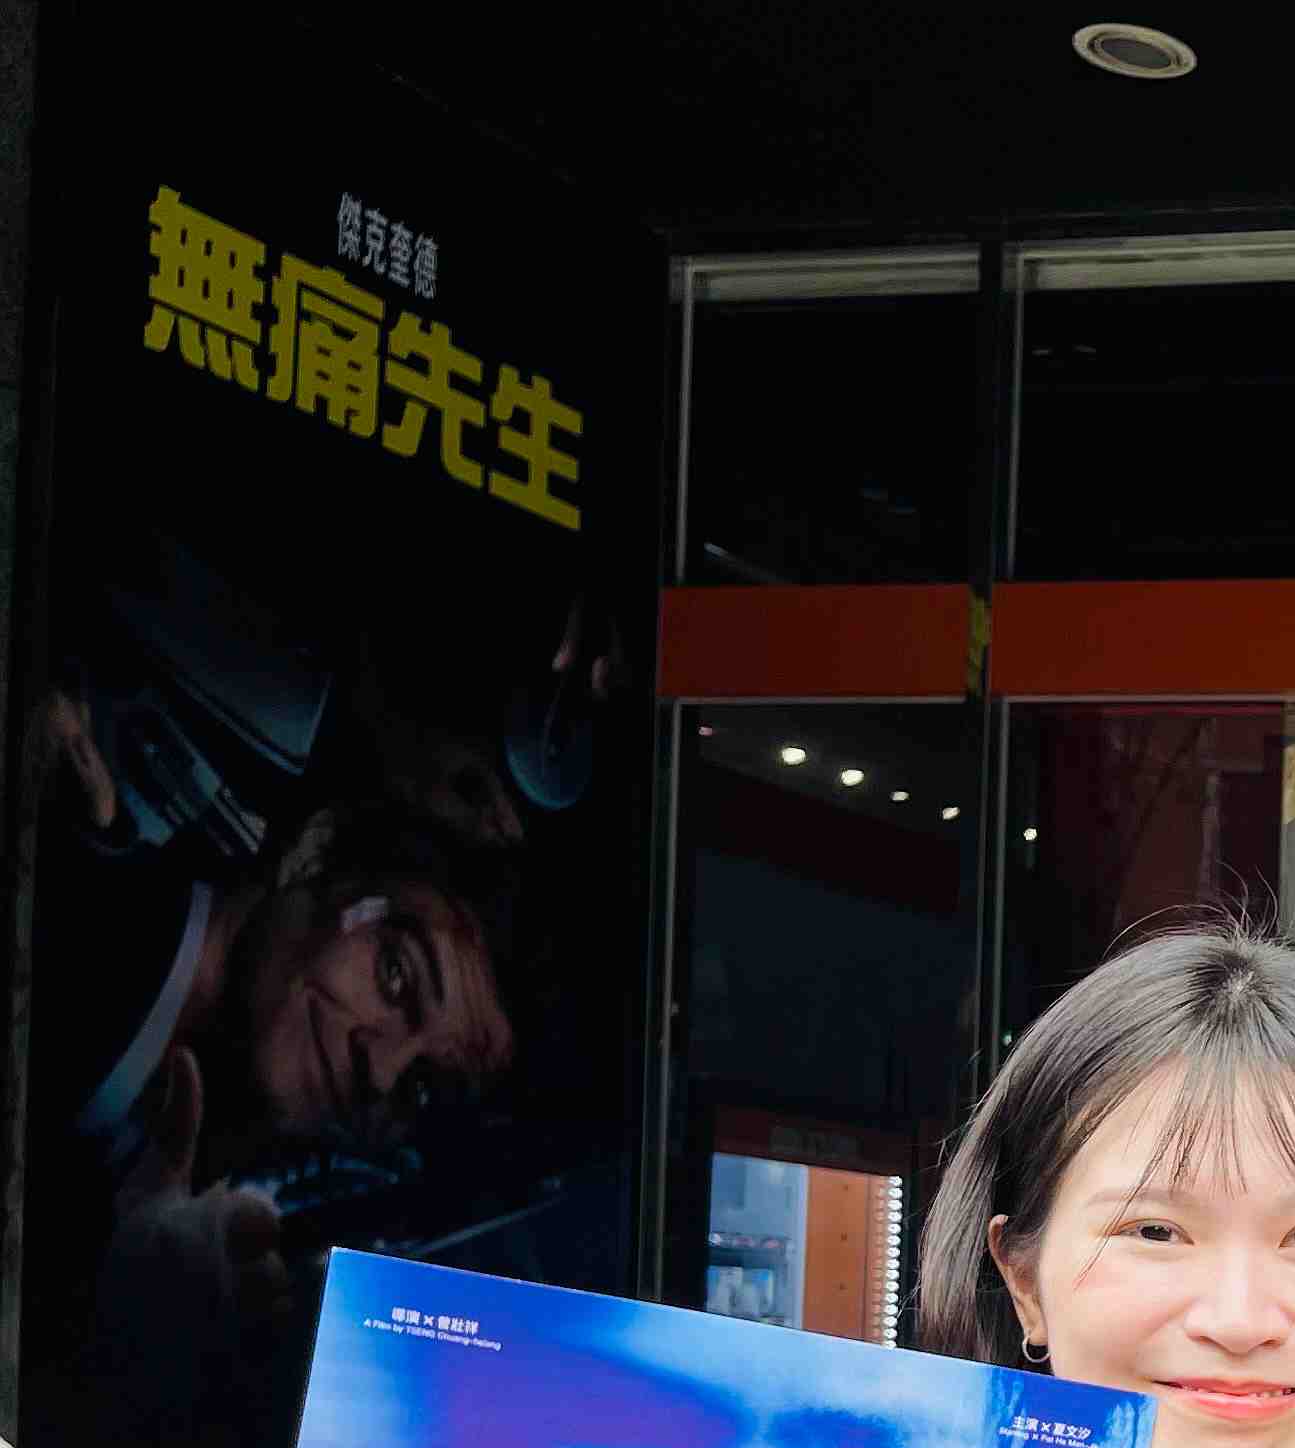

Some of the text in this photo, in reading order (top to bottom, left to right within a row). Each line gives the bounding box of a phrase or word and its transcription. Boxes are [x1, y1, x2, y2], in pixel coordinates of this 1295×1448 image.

[144, 185, 583, 530] 無痛先生
[337, 192, 438, 300] 傑克奎德
